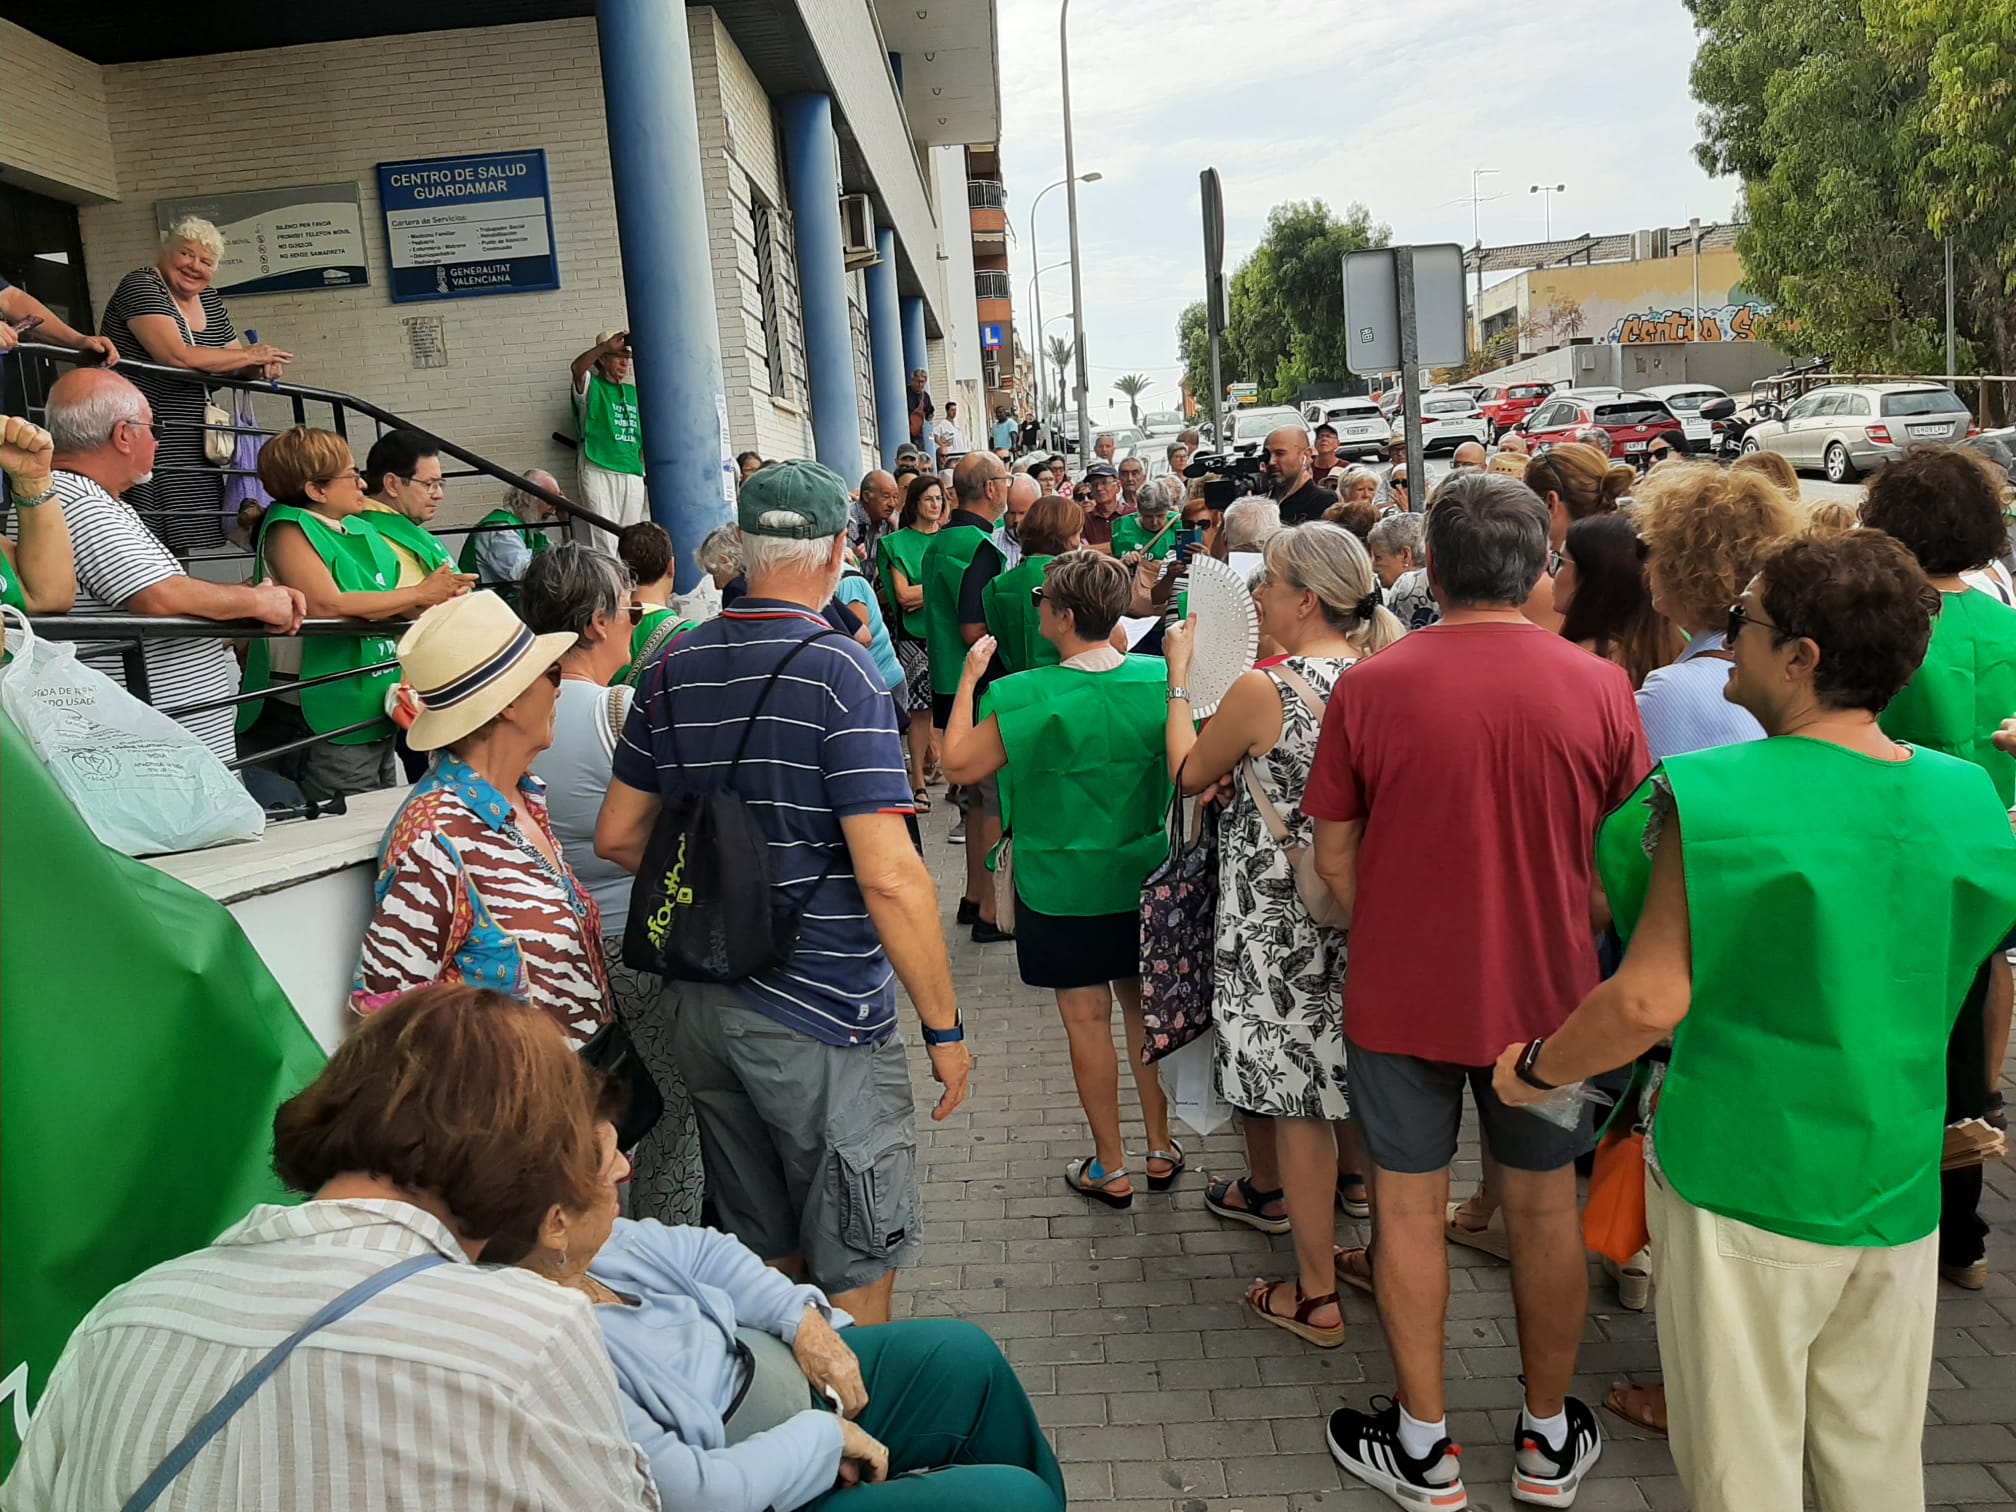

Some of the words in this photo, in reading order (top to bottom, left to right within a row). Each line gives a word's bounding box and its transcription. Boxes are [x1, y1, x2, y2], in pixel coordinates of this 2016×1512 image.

[391, 170, 450, 187] CENTRO
[455, 168, 474, 181] DE
[478, 164, 527, 178] SALUD
[414, 180, 508, 200] GUARDAMAR
[450, 264, 511, 277] GENERALITAT
[451, 274, 511, 286] VALENCIANA
[985, 327, 999, 344] L
